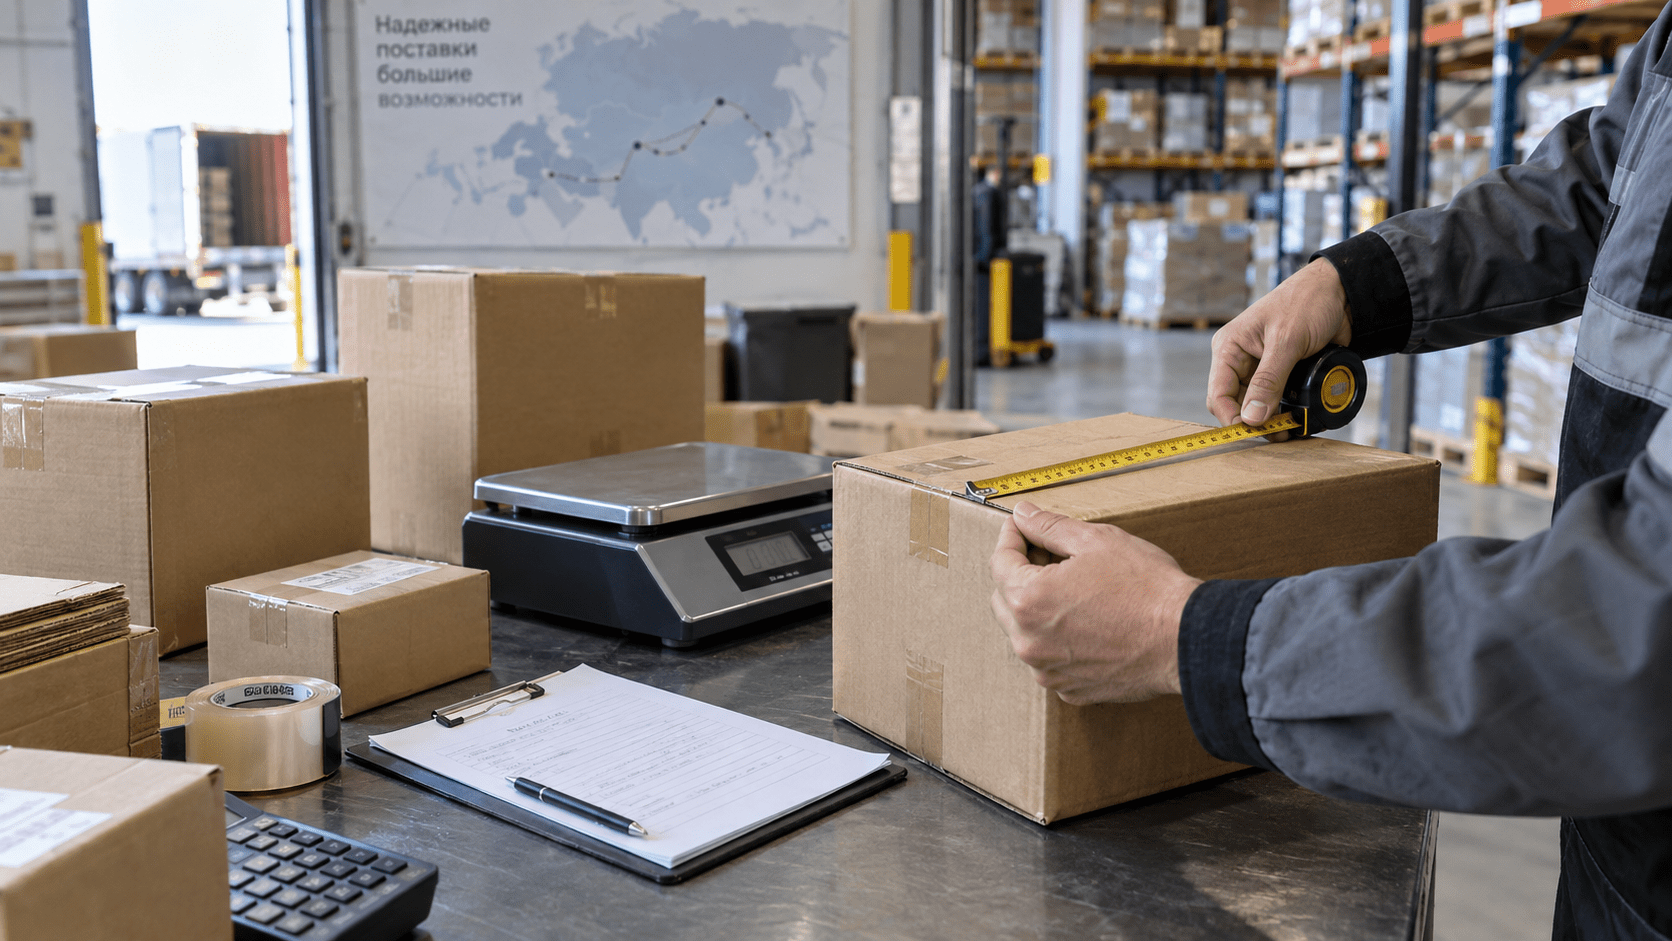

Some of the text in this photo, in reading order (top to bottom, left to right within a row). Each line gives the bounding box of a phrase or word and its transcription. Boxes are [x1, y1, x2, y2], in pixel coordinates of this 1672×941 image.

[375, 15, 491, 36] Надежные
[376, 43, 478, 58] поставки
[377, 64, 473, 84] большие
[378, 92, 523, 108] возможности
